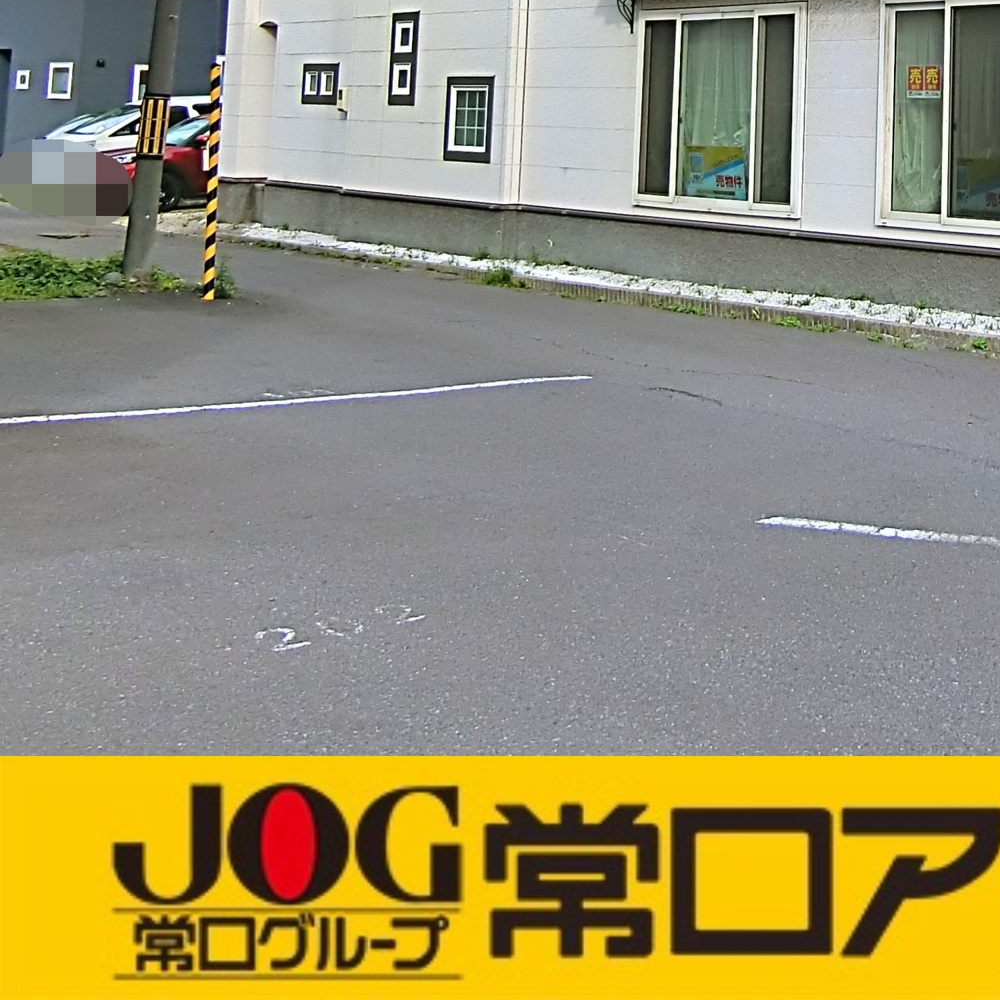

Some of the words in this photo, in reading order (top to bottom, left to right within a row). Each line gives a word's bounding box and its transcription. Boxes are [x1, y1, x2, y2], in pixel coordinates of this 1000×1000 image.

[910, 68, 921, 83] 売
[927, 68, 938, 83] 売
[715, 175, 743, 188] 売物件
